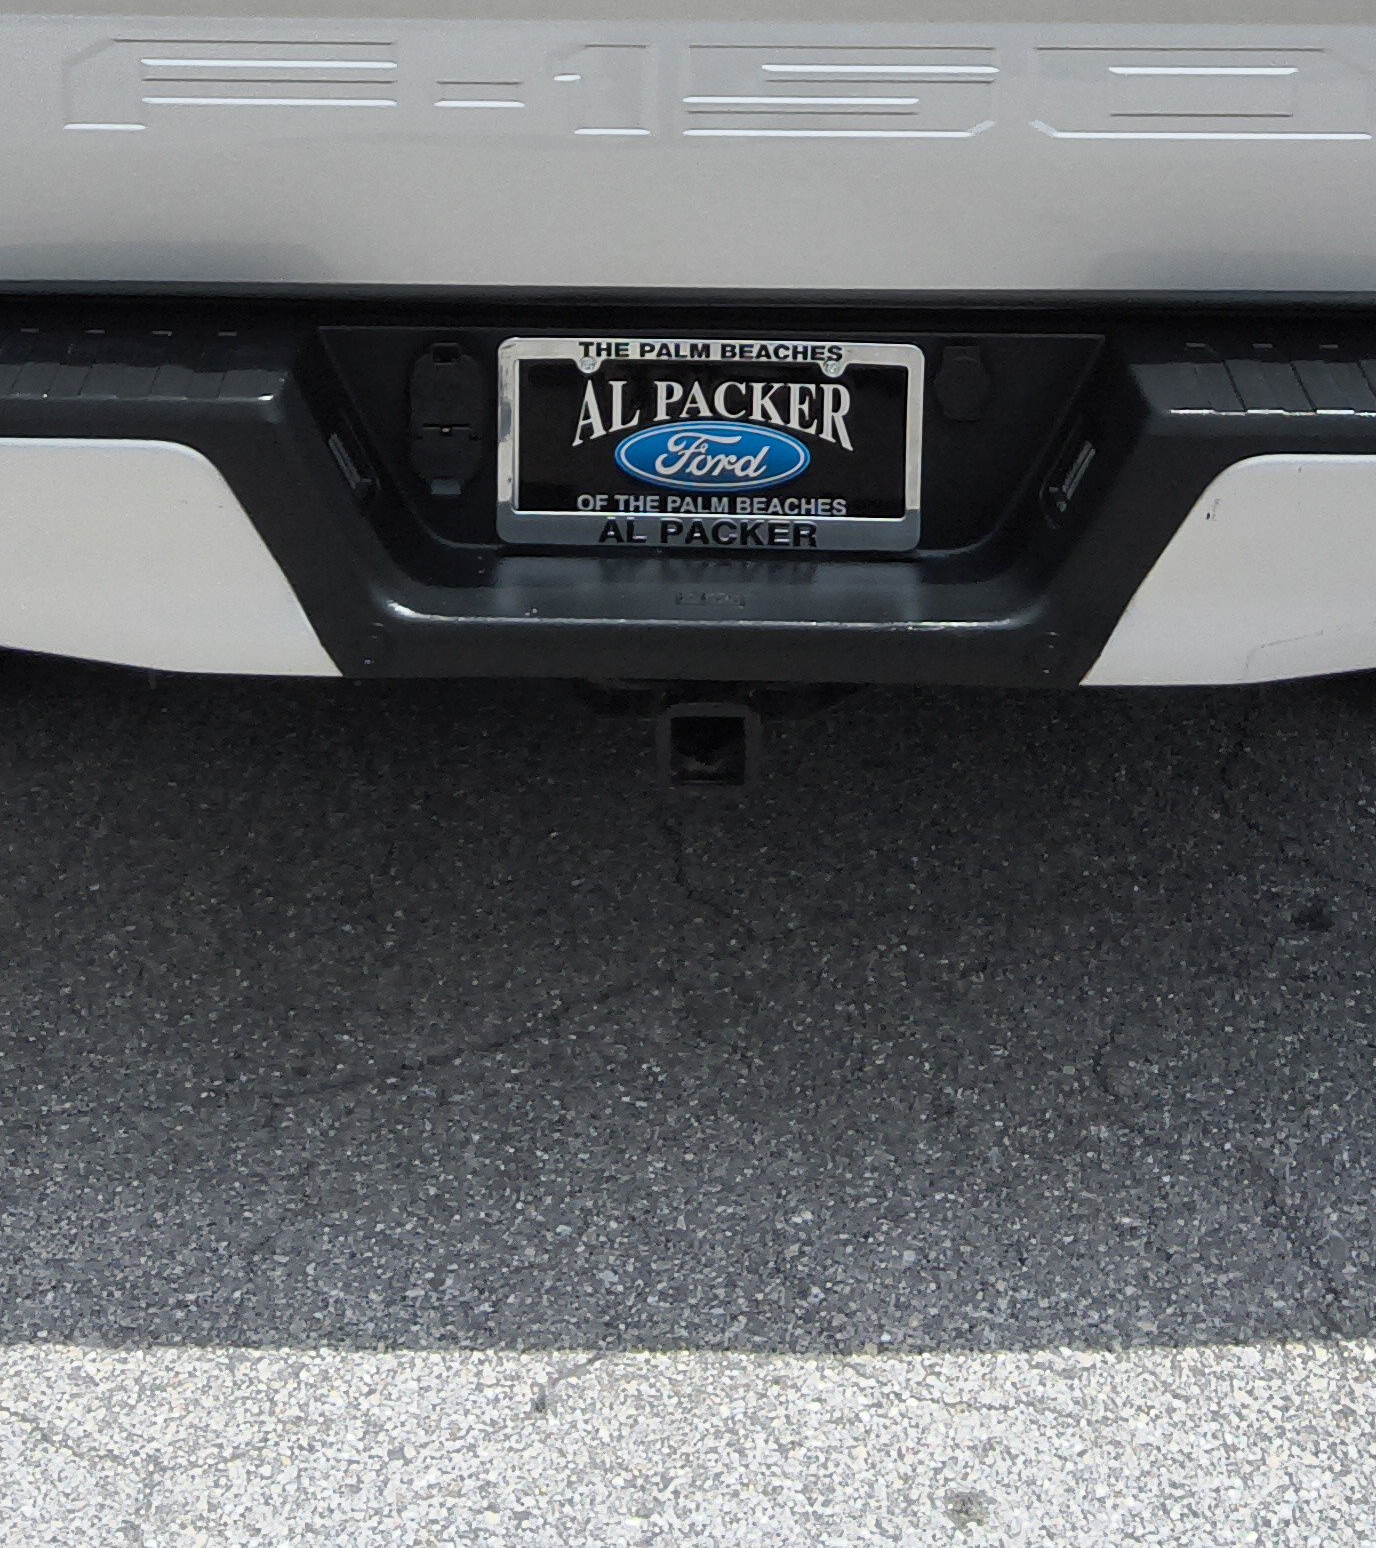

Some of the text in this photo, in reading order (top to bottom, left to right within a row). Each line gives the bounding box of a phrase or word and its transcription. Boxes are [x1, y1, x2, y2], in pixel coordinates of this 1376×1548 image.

[62, 38, 1376, 140] F-150
[579, 341, 843, 362] THE PALM BEACHES
[572, 380, 854, 452] AL PACKER
[654, 431, 772, 478] Ford
[577, 494, 847, 516] OF THE PALM BEACHES
[598, 517, 818, 548] AL PACKER
